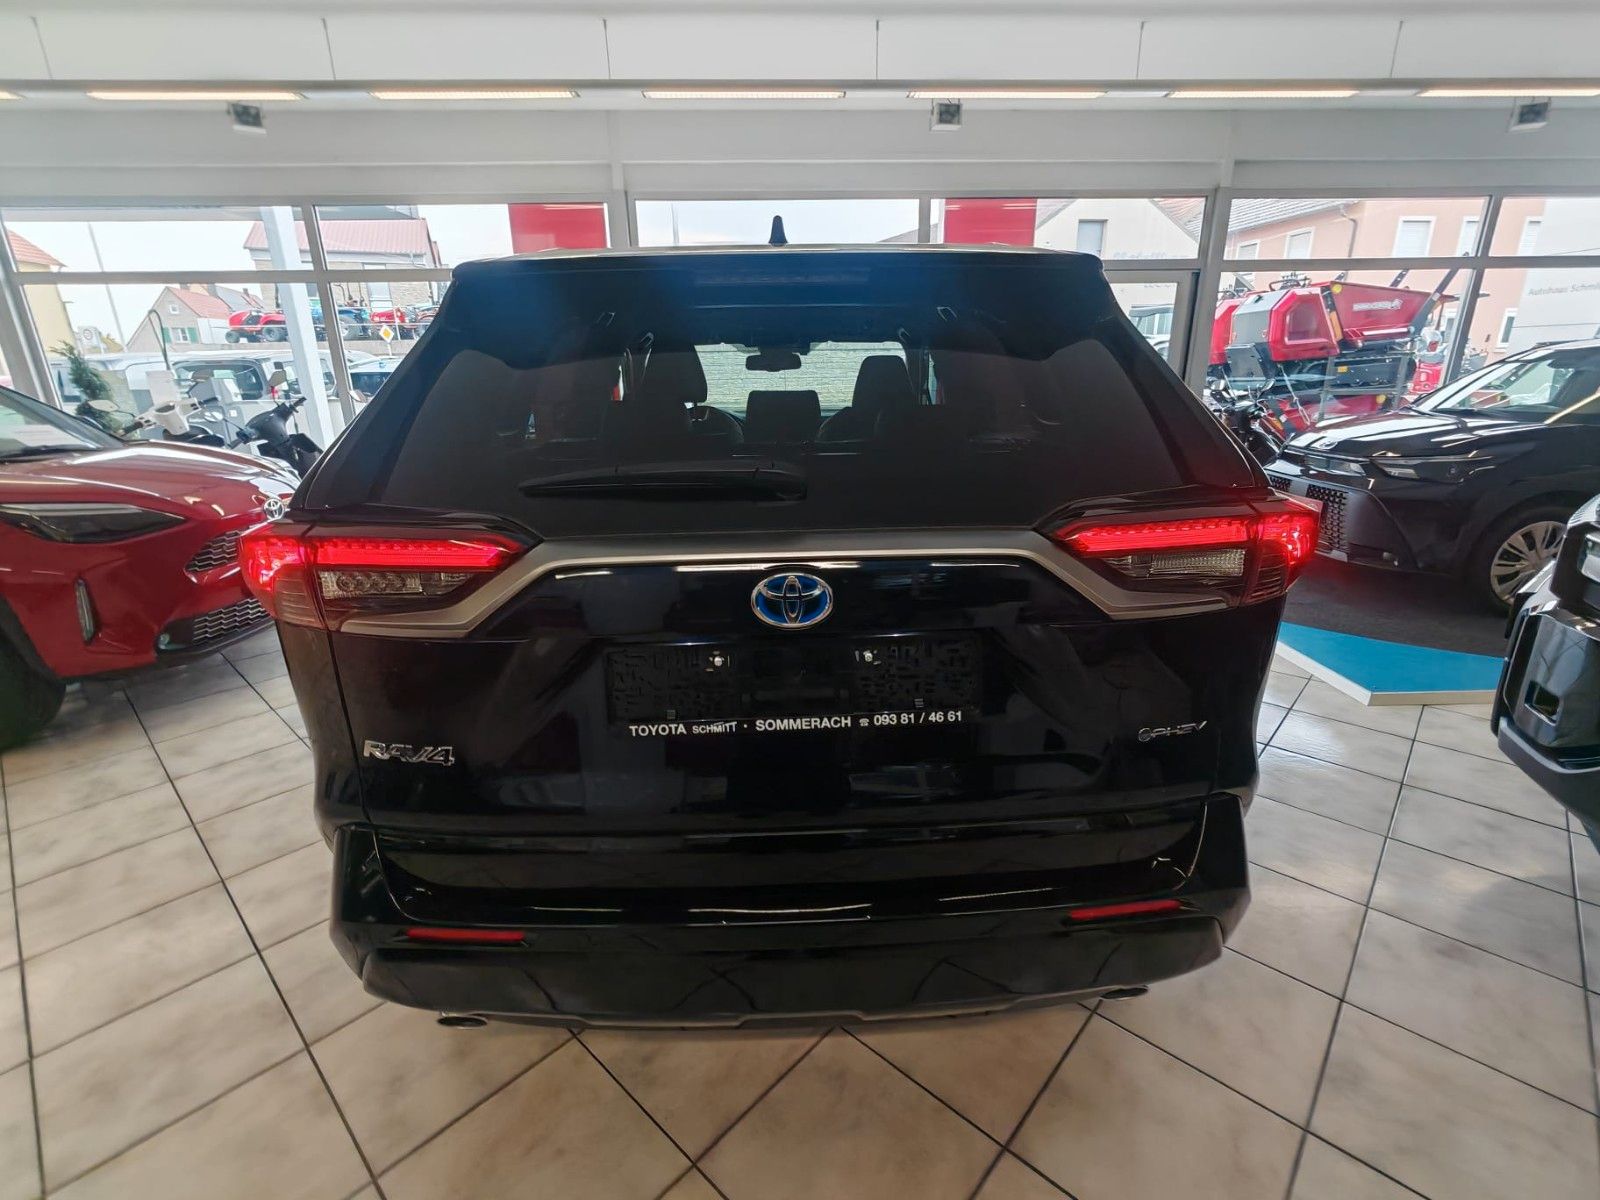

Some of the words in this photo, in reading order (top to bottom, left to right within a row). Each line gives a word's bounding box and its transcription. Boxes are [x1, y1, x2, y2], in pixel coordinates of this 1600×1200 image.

[629, 723, 687, 737] TOYOTA
[692, 721, 738, 735] SCHMITT
[755, 716, 851, 732] SOMMERACH
[873, 713, 898, 726] 093
[900, 712, 915, 725] 81
[928, 711, 945, 723] 46
[947, 710, 962, 722] 61
[363, 739, 455, 767] RAV4
